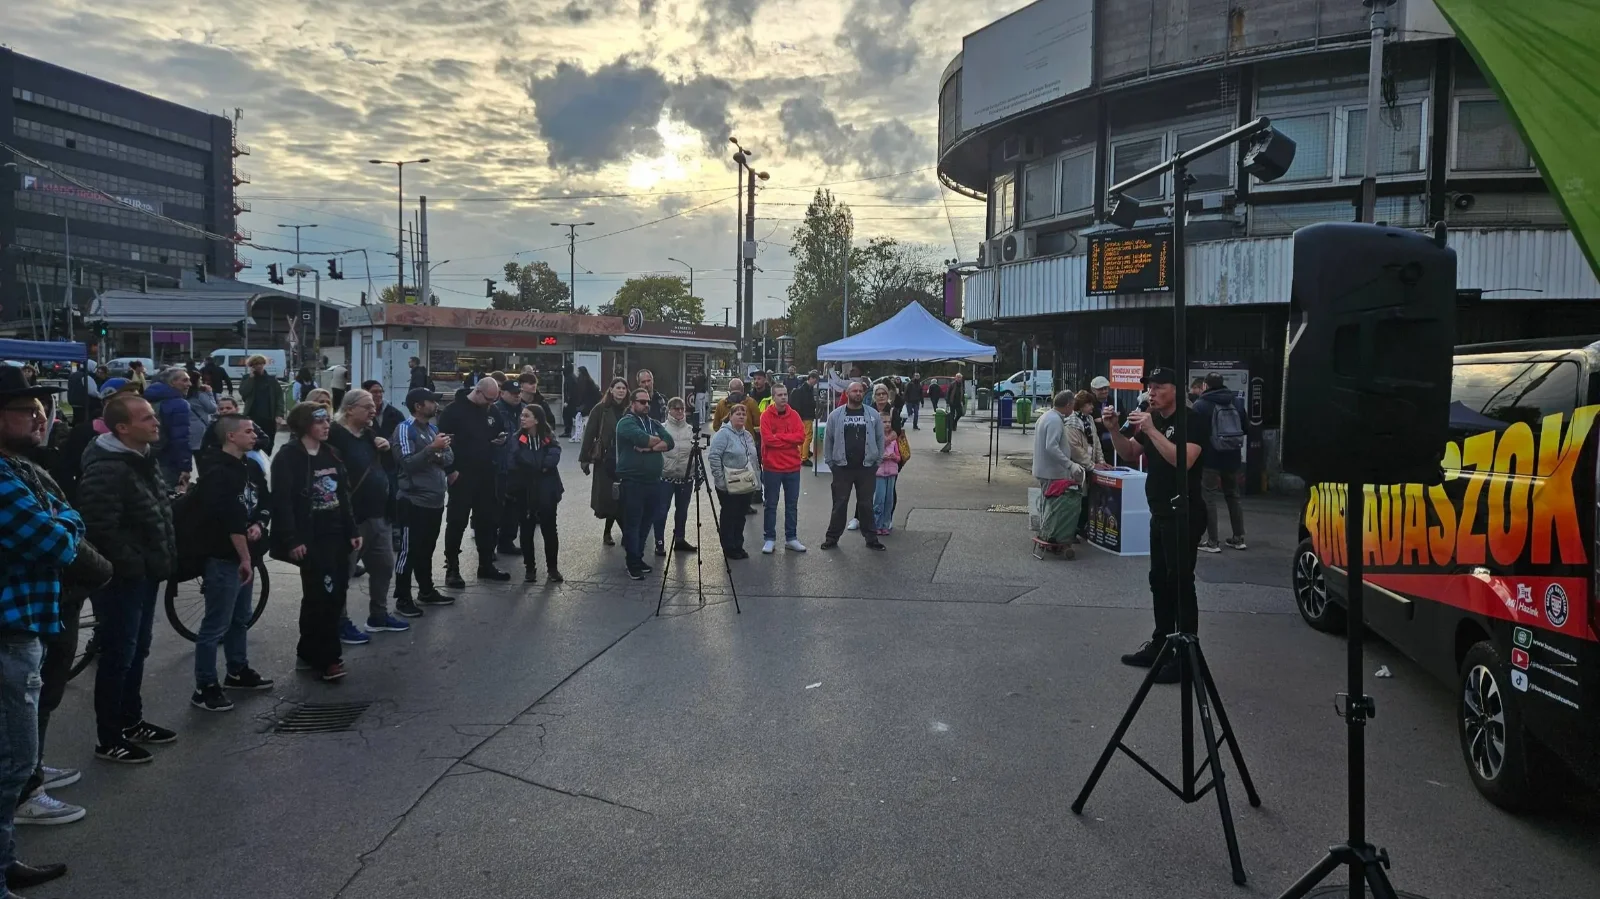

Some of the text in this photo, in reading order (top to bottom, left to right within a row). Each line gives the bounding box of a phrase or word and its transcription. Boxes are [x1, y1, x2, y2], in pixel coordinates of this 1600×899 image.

[475, 311, 559, 330] Friss pékáru
[1506, 598, 1516, 609] Mi
